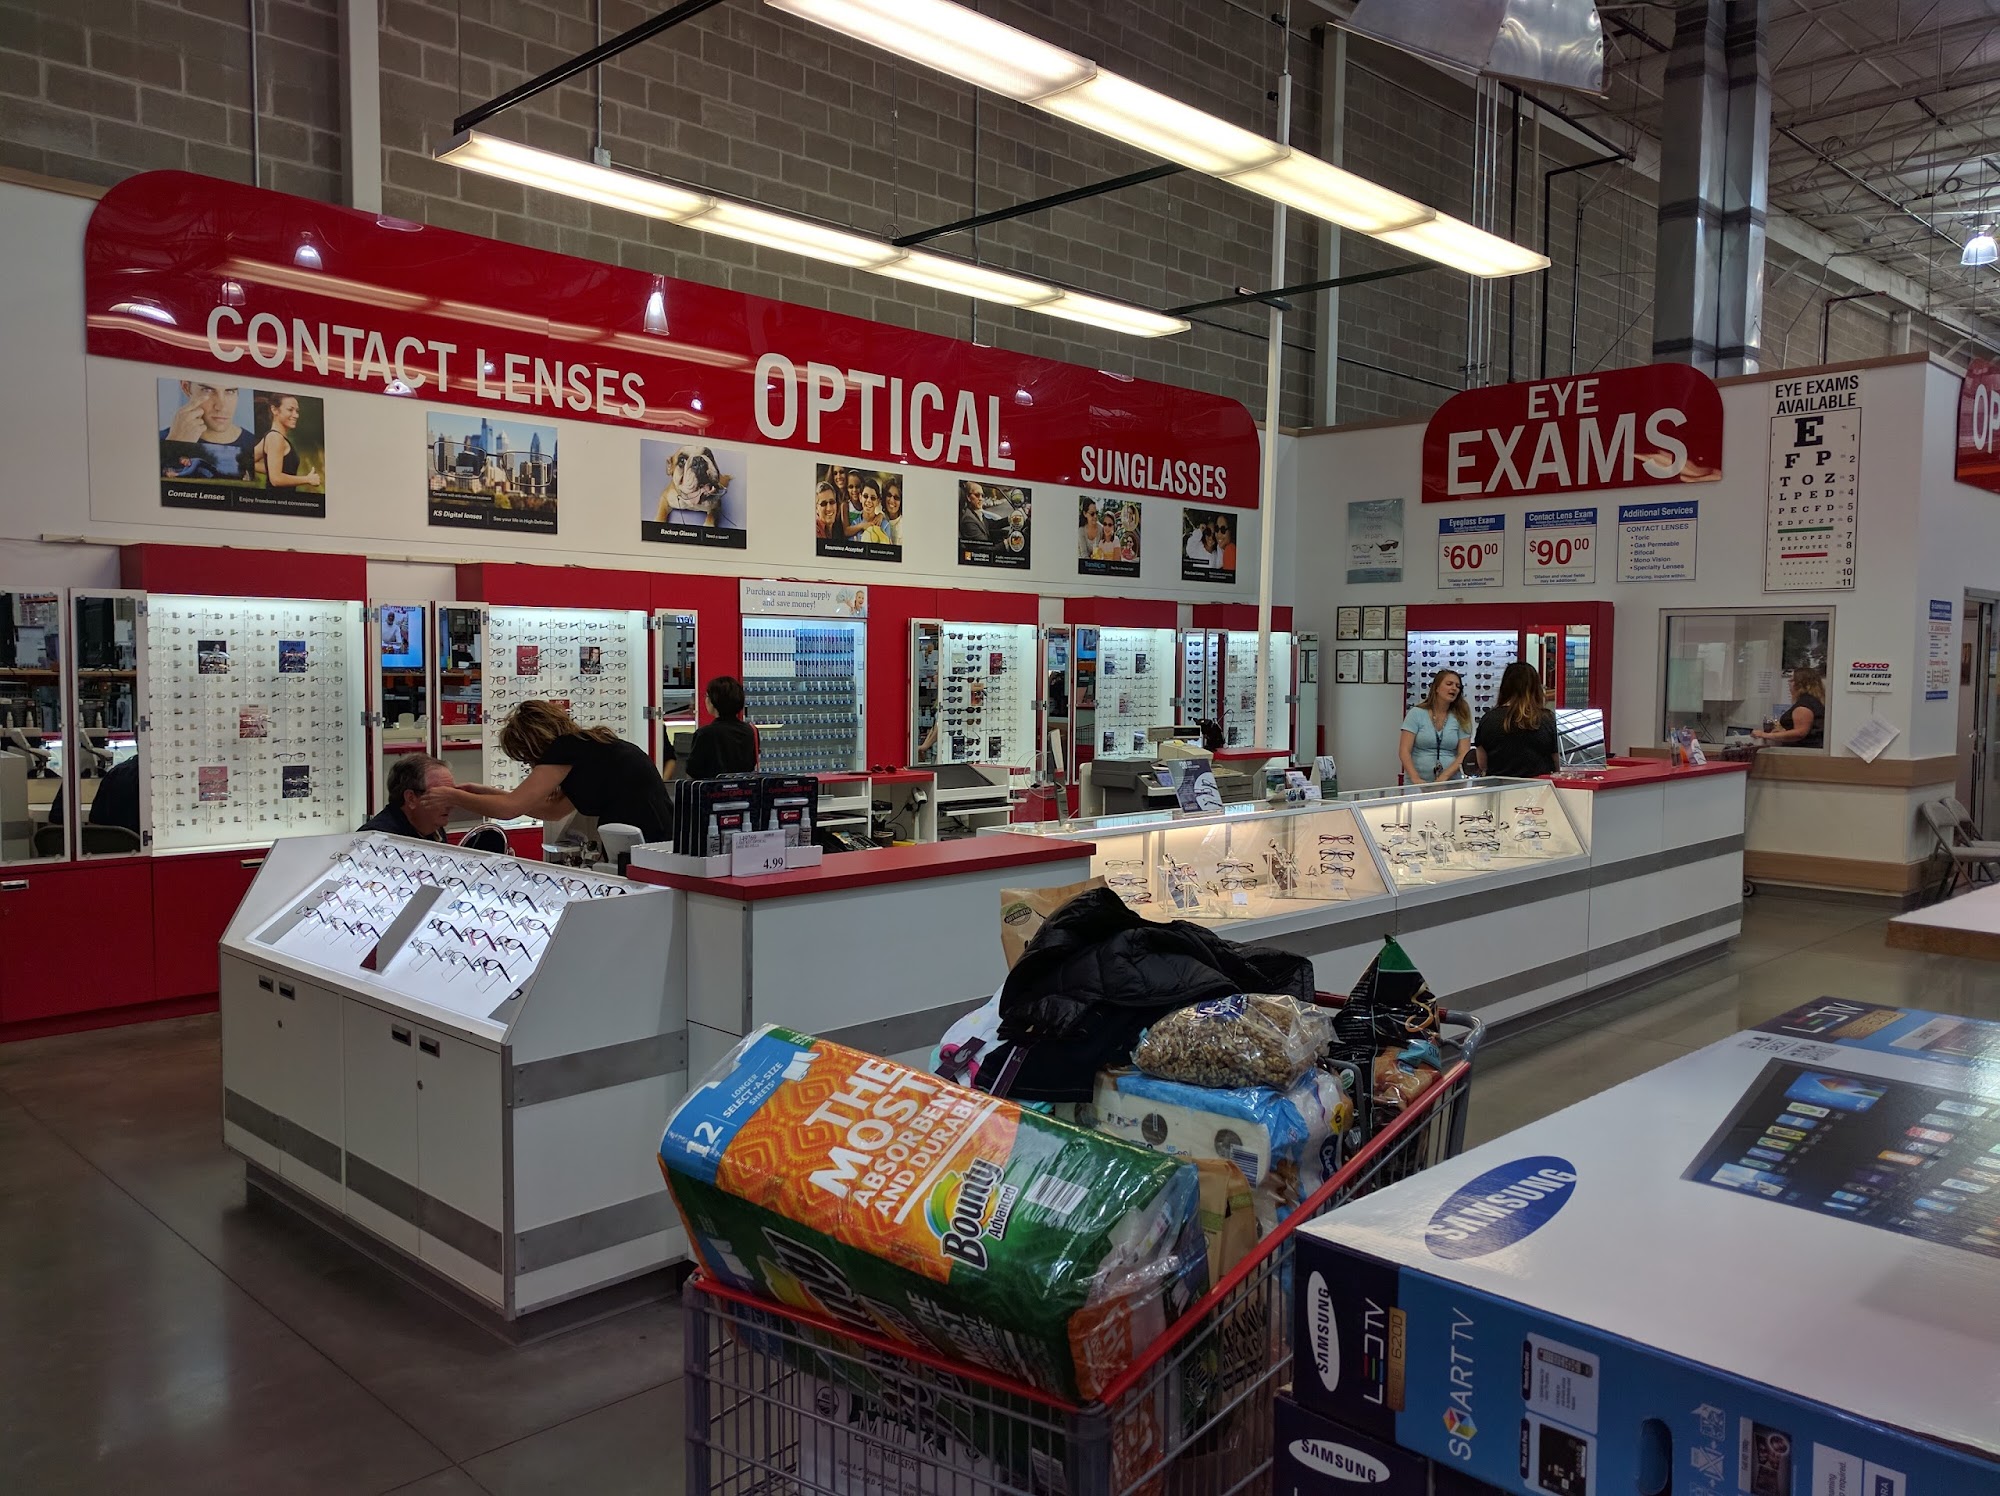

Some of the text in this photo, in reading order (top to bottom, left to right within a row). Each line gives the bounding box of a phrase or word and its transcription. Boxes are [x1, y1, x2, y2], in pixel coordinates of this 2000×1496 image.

[206, 305, 646, 419] CONTACT LENSES
[1775, 375, 1859, 398] EYE EXAMS
[1528, 378, 1600, 419] EYE
[1776, 392, 1856, 414] AVAILABLE
[754, 352, 1015, 472] OPTICAL
[1794, 416, 1824, 447] E
[1446, 407, 1688, 496] EXAMS
[1785, 451, 1831, 468] F P
[1081, 445, 1227, 500] SUNGLASSES
[1780, 473, 1835, 487] T O Z
[1849, 474, 1855, 482] 3
[167, 489, 225, 501] Contact Lenses
[1848, 488, 1854, 496] 4
[443, 510, 464, 520] Digital
[1528, 510, 1594, 522] Contact Lens Exam
[1623, 506, 1694, 518] Additional Services
[1847, 502, 1853, 510] 5
[1449, 516, 1496, 527] Eyeglass Exam
[1847, 515, 1853, 523] 6
[660, 528, 698, 538] Backup Glasses
[1846, 531, 1852, 539] 7
[825, 544, 844, 552] Insurance
[1846, 541, 1852, 549] 8
[1845, 557, 1851, 565] 9
[1843, 578, 1851, 586] 11
[746, 586, 776, 596] Purchase
[811, 590, 831, 600] supply
[791, 600, 816, 610] money!
[763, 857, 784, 870] 4.99
[1004, 906, 1032, 924] AUTHENTIC
[731, 1073, 758, 1099] LONGER
[803, 1058, 900, 1128] THE
[686, 1121, 724, 1158] 12
[808, 1070, 939, 1200] MOST
[853, 1086, 965, 1209] ABSORBENT
[874, 1090, 985, 1217] AND DURABLE
[942, 1158, 1005, 1270] Bounty
[988, 1186, 1018, 1239] Advanced
[1427, 1168, 1577, 1240] SAMSUNG
[1317, 1287, 1330, 1374] SAMSUNG
[1452, 1307, 1474, 1340] TV
[1301, 1439, 1377, 1483] SAMSUNG
[1838, 1461, 1847, 1491] required.
